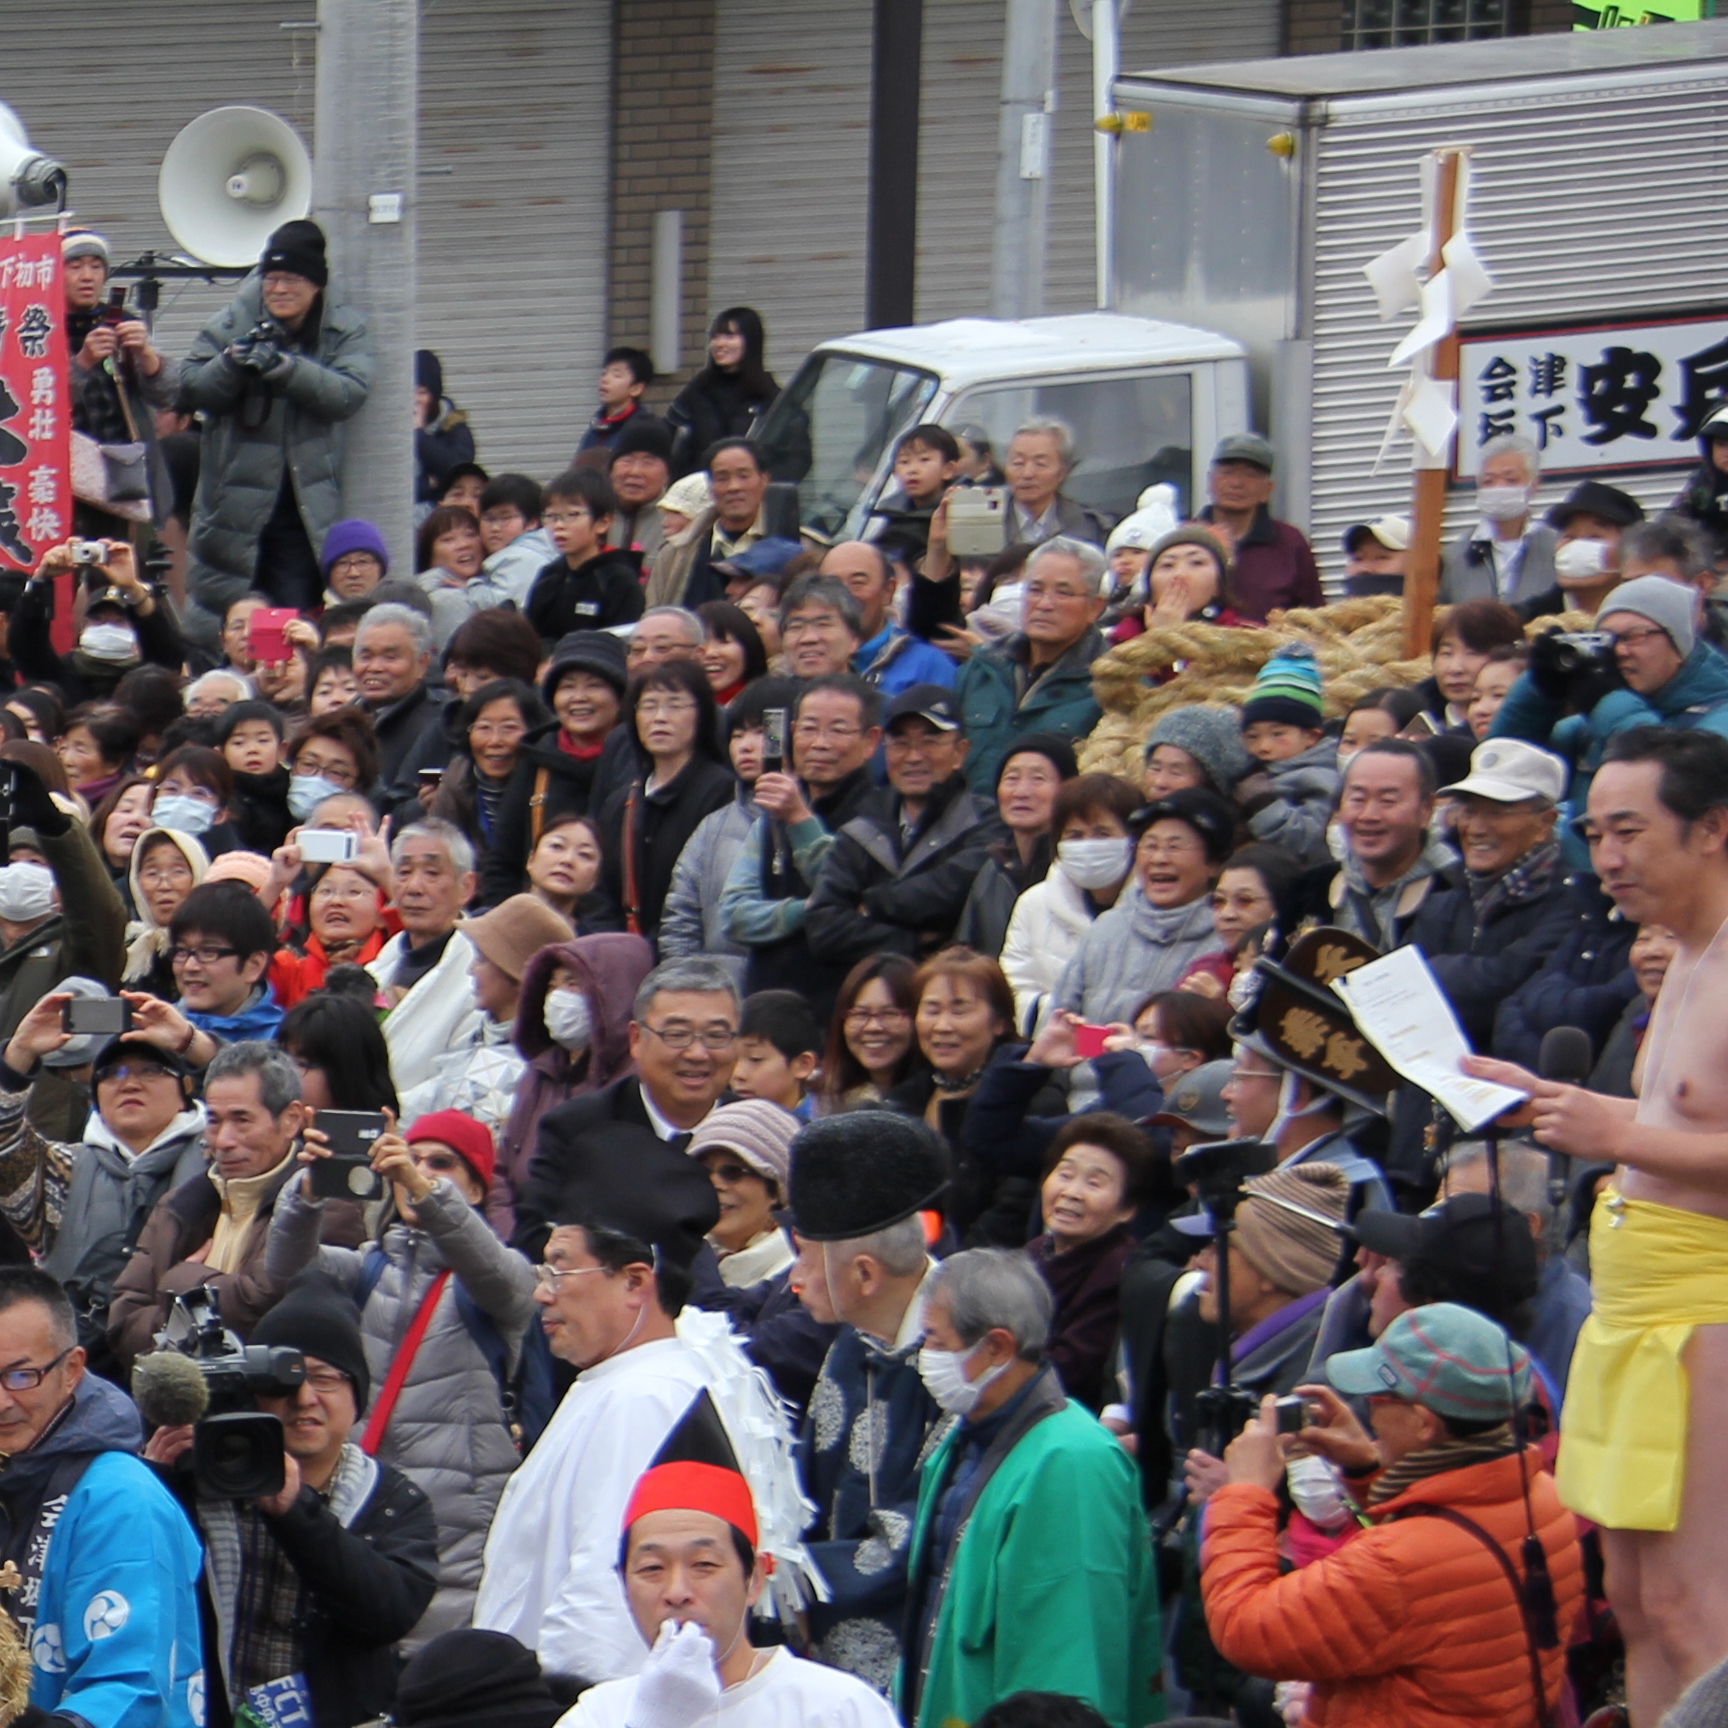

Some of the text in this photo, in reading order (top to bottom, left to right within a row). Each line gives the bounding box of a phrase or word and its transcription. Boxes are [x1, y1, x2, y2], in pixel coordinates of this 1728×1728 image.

[25, 367, 62, 542] 勇壮 豪快
[266, 1675, 309, 1724] FCT
